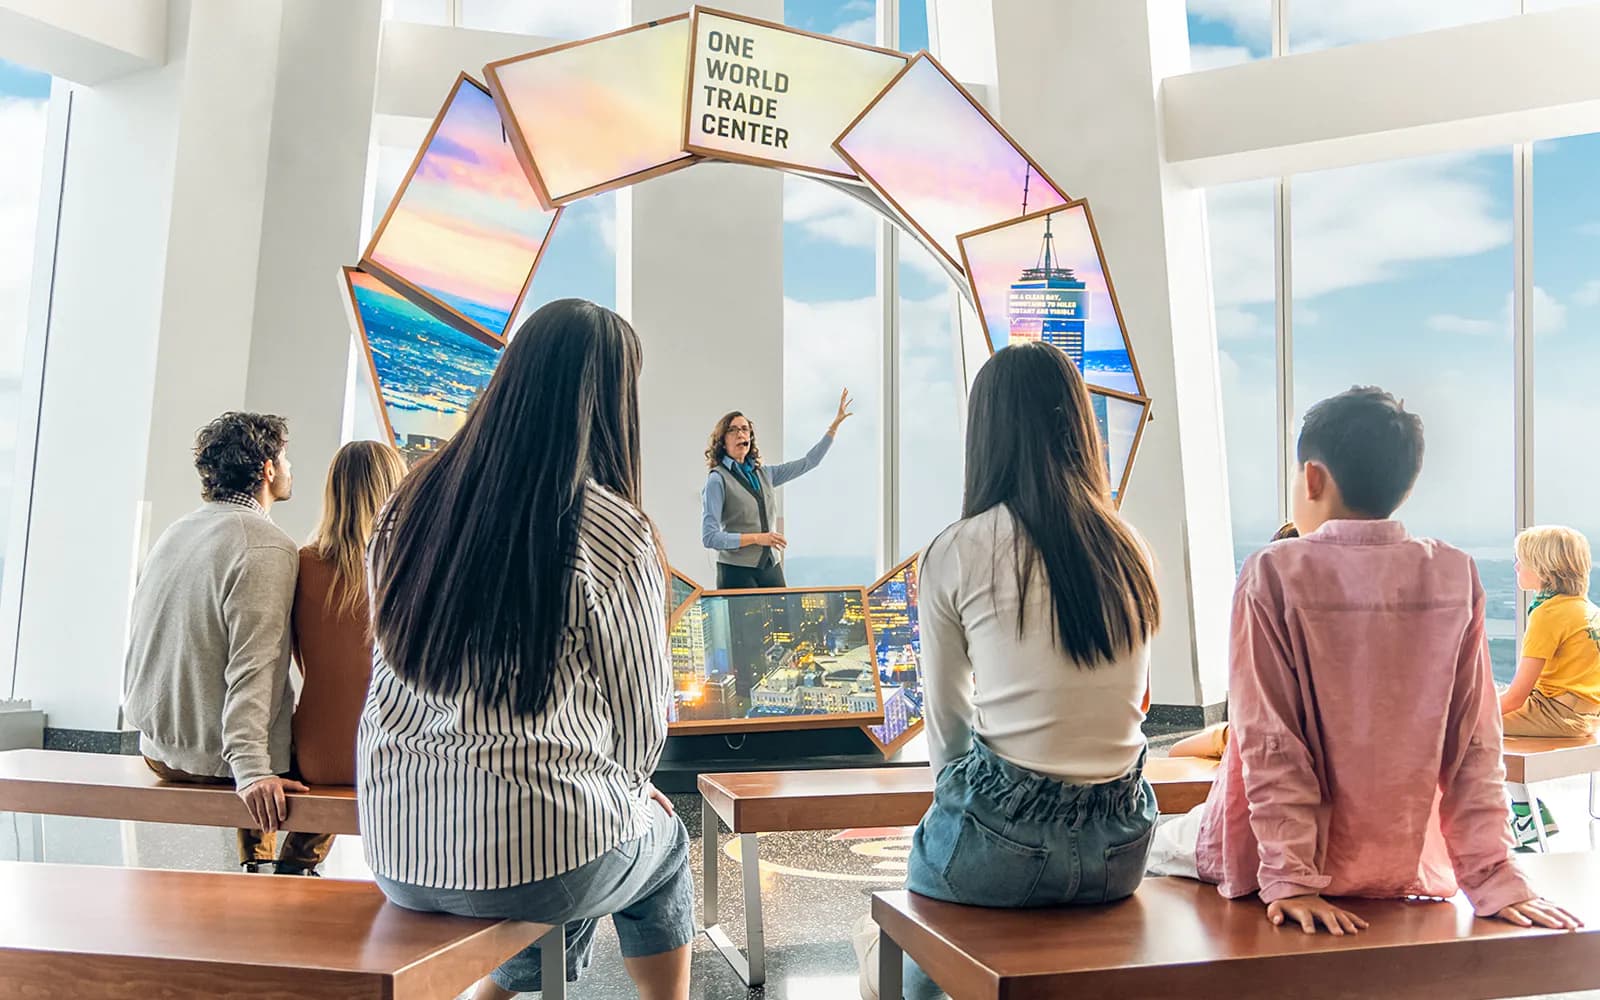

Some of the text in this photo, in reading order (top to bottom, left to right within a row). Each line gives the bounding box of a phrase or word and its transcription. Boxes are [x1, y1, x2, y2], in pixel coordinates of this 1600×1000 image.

[708, 31, 754, 59] ONE
[706, 57, 789, 93] WORLD
[703, 85, 778, 120] TRADE
[702, 113, 788, 149] CENTER
